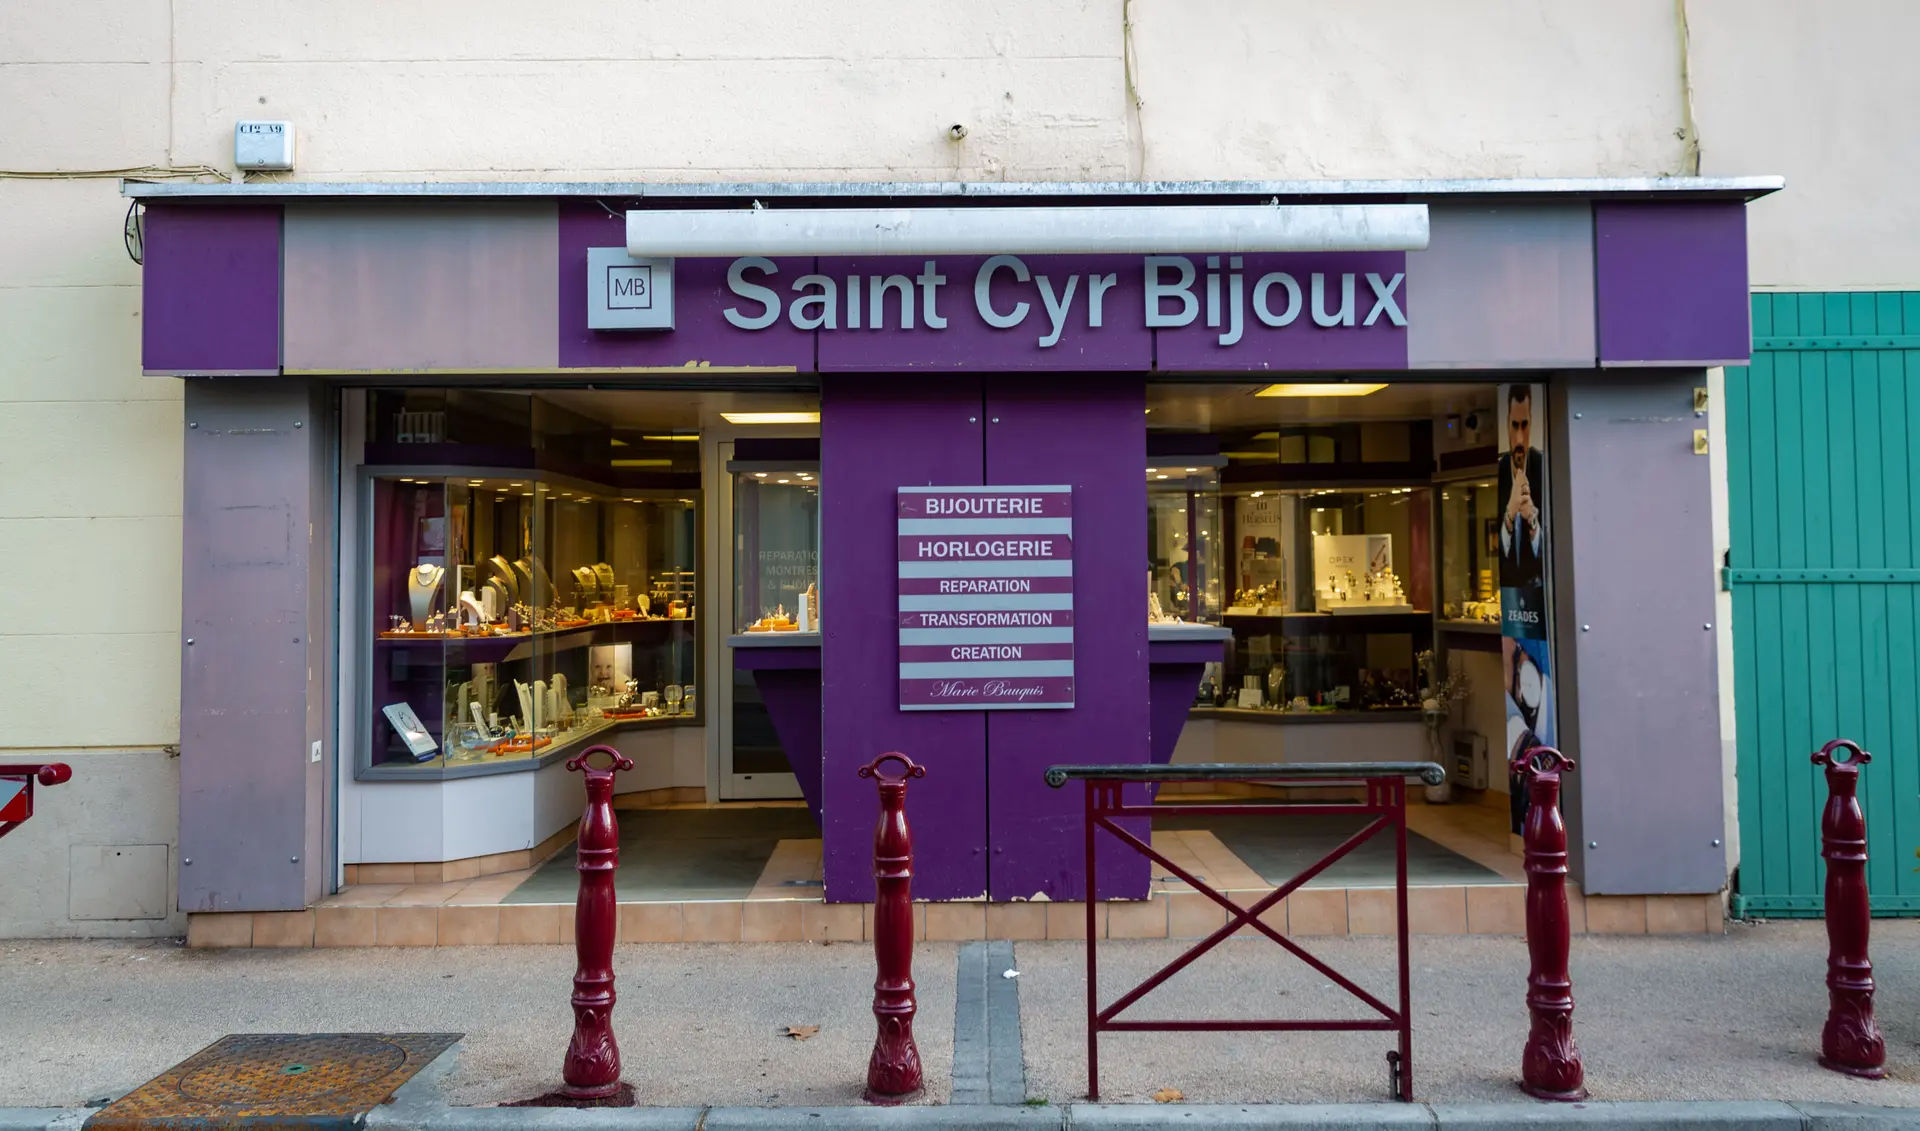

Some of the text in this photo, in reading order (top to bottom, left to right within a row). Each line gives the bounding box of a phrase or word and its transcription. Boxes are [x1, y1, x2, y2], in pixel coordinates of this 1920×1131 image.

[614, 278, 645, 296] MB
[722, 255, 1408, 348] Saint Cyr Bijoux
[925, 498, 1043, 514] BIJOUTERIE
[918, 540, 1053, 557] HORLOGERIE
[1329, 556, 1354, 564] OPEX
[766, 565, 818, 576] MONTRES
[940, 579, 1030, 593] REPARATION
[919, 612, 1052, 627] TRANSFORMATION
[1508, 610, 1539, 623] ZEADES
[951, 646, 1022, 660] CREATION
[930, 680, 1044, 701] Marie Bauquis
